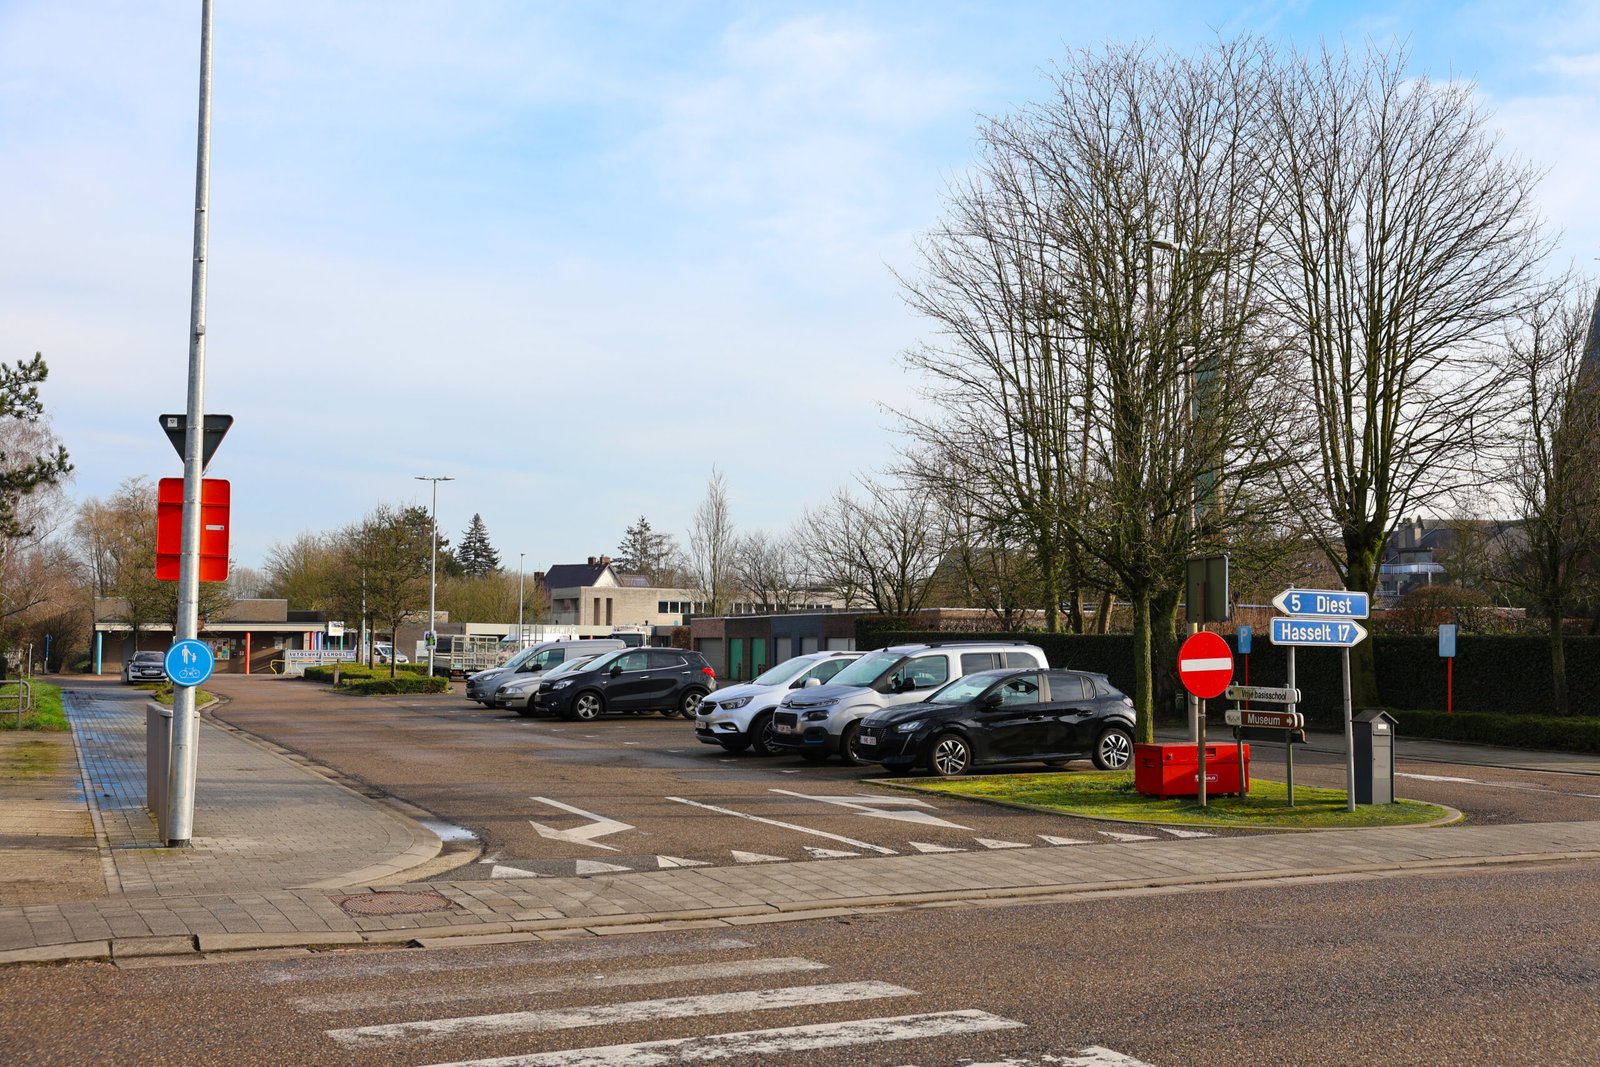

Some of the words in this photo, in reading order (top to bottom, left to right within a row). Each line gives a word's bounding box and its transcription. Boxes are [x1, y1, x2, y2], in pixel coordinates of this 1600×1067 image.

[1291, 594, 1301, 612] 5
[1316, 595, 1352, 614] Diest
[1240, 628, 1248, 643] P
[1281, 622, 1332, 641] Hasselt
[1337, 624, 1350, 642] 17
[1241, 689, 1254, 700] Vrije
[1254, 689, 1287, 701] basisschool
[1247, 713, 1281, 726] Museum
